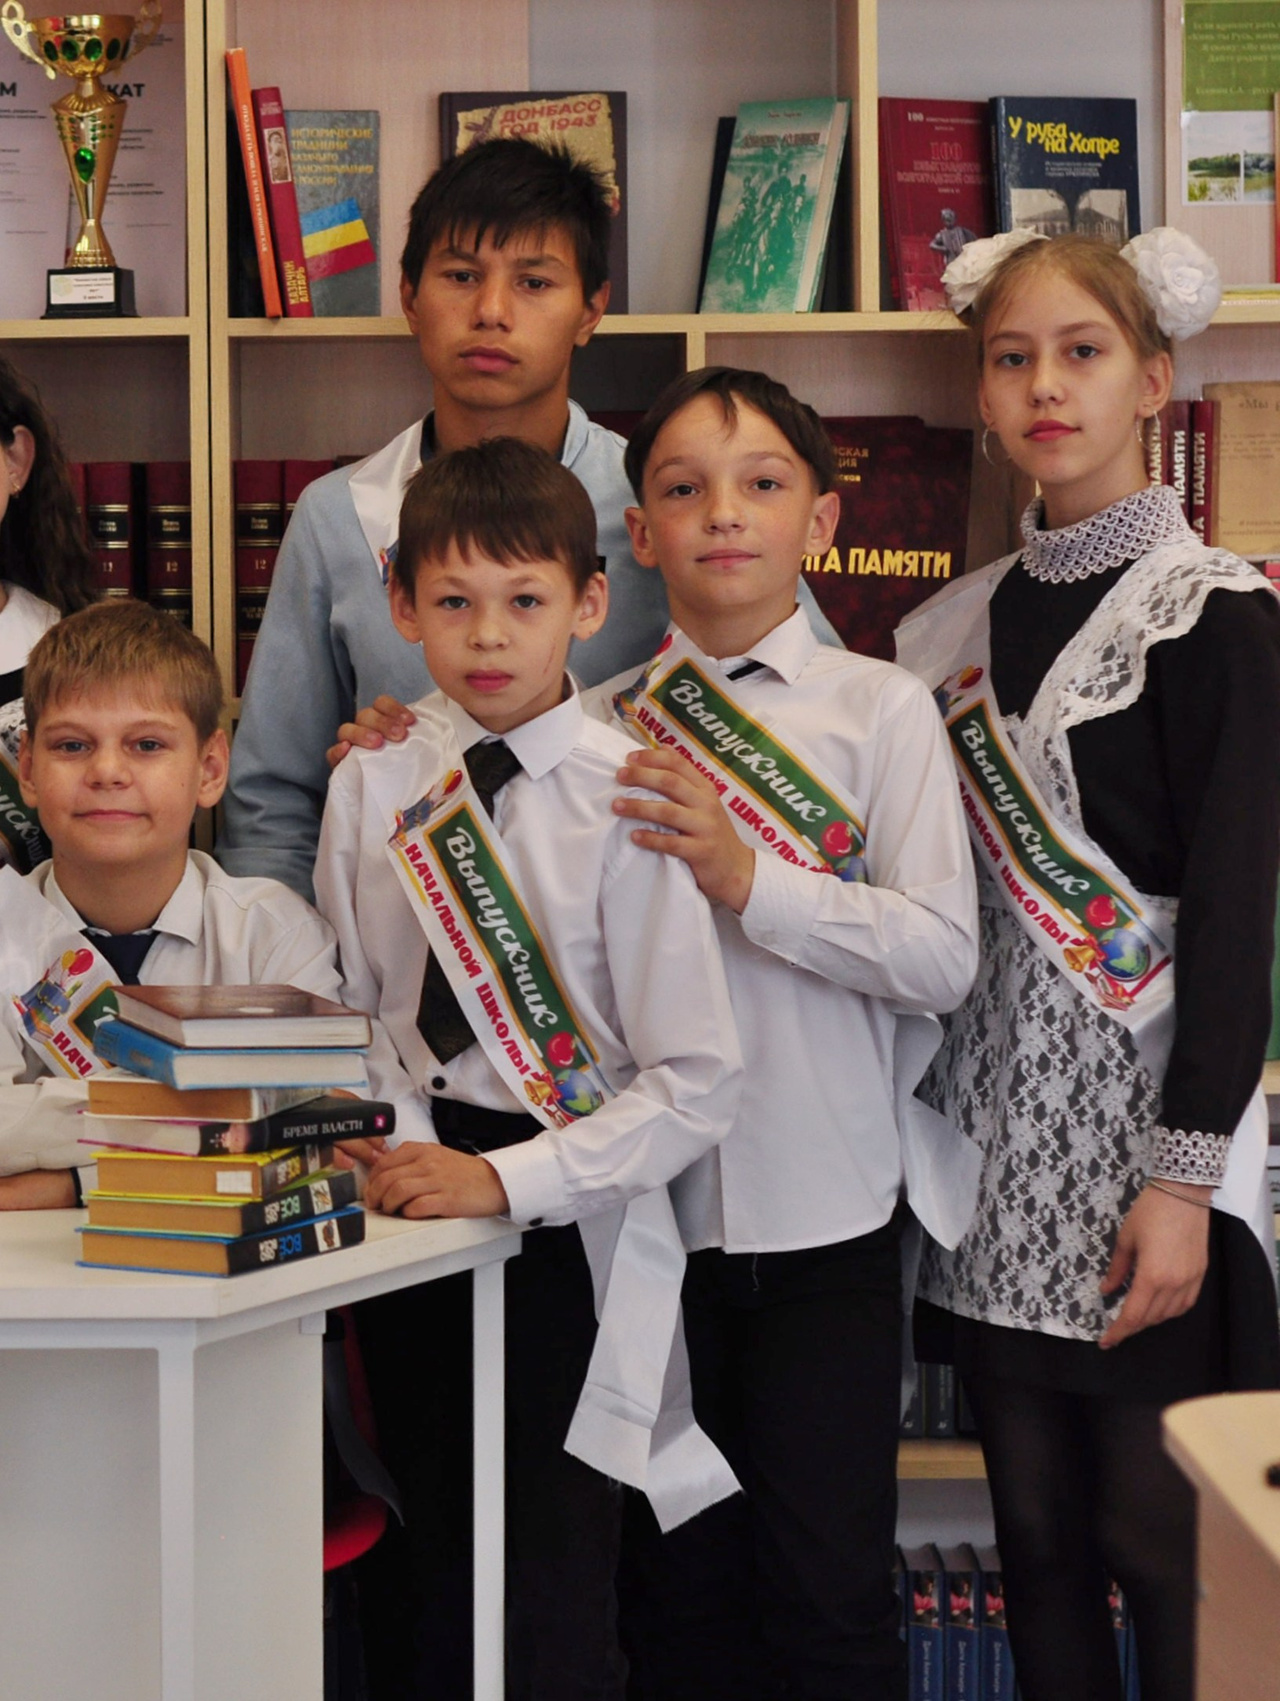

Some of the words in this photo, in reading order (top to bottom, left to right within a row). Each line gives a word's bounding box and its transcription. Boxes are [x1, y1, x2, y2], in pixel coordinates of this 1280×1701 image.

[104, 82, 145, 98] КАТ
[499, 99, 601, 124] ДОНБАСС
[907, 112, 924, 122] 100
[291, 127, 373, 139] ИСТОРИЧЕСКИЕ
[500, 121, 539, 138] ГОД
[549, 114, 597, 131] 1943
[1008, 115, 1022, 139] У
[292, 140, 349, 150] ТРАДИЦИИ
[1045, 136, 1066, 154] на
[1069, 132, 1120, 160] Хопре
[296, 266, 310, 304] АЛТАРЬ
[834, 446, 869, 458] СКАЯ
[836, 474, 861, 482] ская
[1193, 432, 1206, 505] ПАМЯТИ
[166, 561, 178, 572] 12
[254, 559, 267, 570] 12
[848, 547, 951, 578] ПАМЯТИ
[669, 678, 827, 822] Выпускник
[961, 719, 1090, 896] Выпускник
[959, 781, 1003, 865] АЛЬНОЙ
[1001, 864, 1069, 946] ШКОЛЫ
[445, 826, 559, 1029] Выпускник
[405, 842, 484, 980] НАЧАЛЬНОЙ
[475, 982, 533, 1076] ШКОЛЫ
[52, 1030, 94, 1077] НАЧ
[283, 1121, 318, 1139] БРЕМЯ
[321, 1118, 364, 1134] ВЛАСТИ
